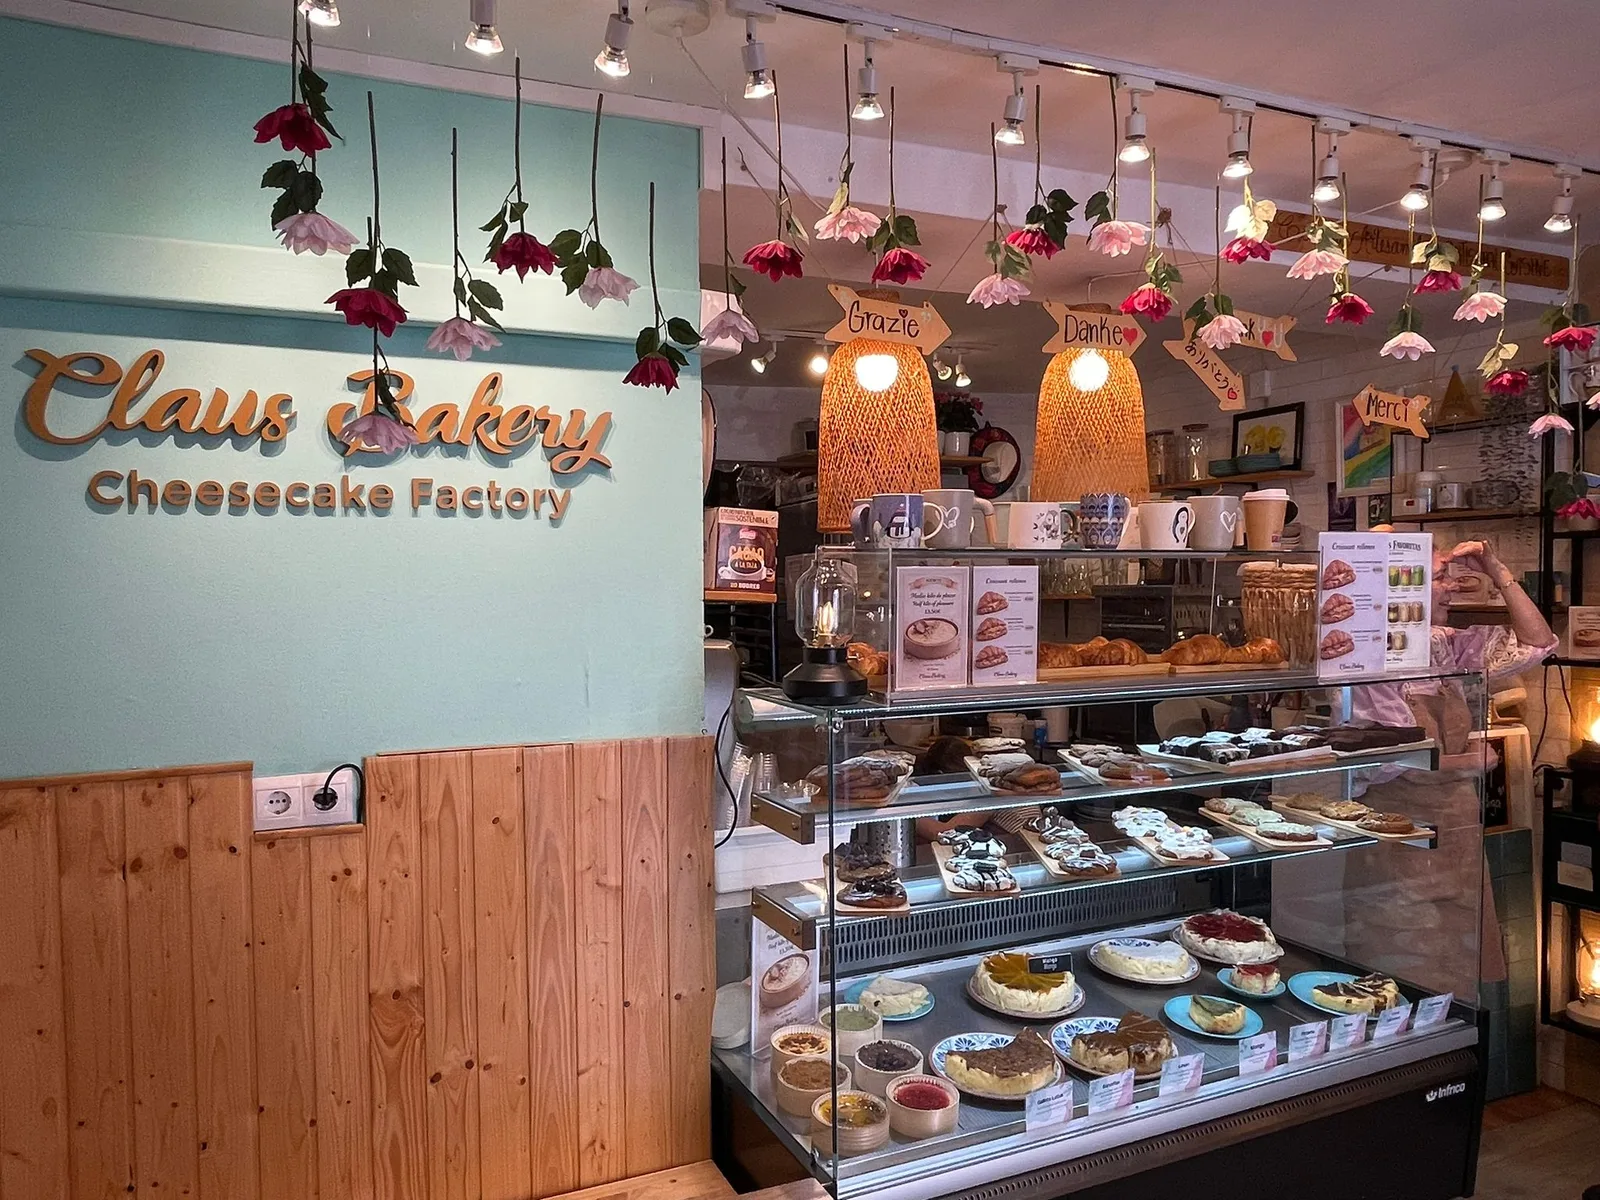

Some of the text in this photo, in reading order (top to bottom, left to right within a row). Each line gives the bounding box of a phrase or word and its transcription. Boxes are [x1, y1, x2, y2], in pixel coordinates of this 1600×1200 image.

[847, 301, 920, 338] Grazie
[1184, 341, 1231, 390] ありがとう
[24, 348, 612, 475] Claus Bakery
[1366, 392, 1409, 423] Merci
[88, 469, 572, 521] Cheesecake Factory
[1438, 1082, 1466, 1099] Infrico
